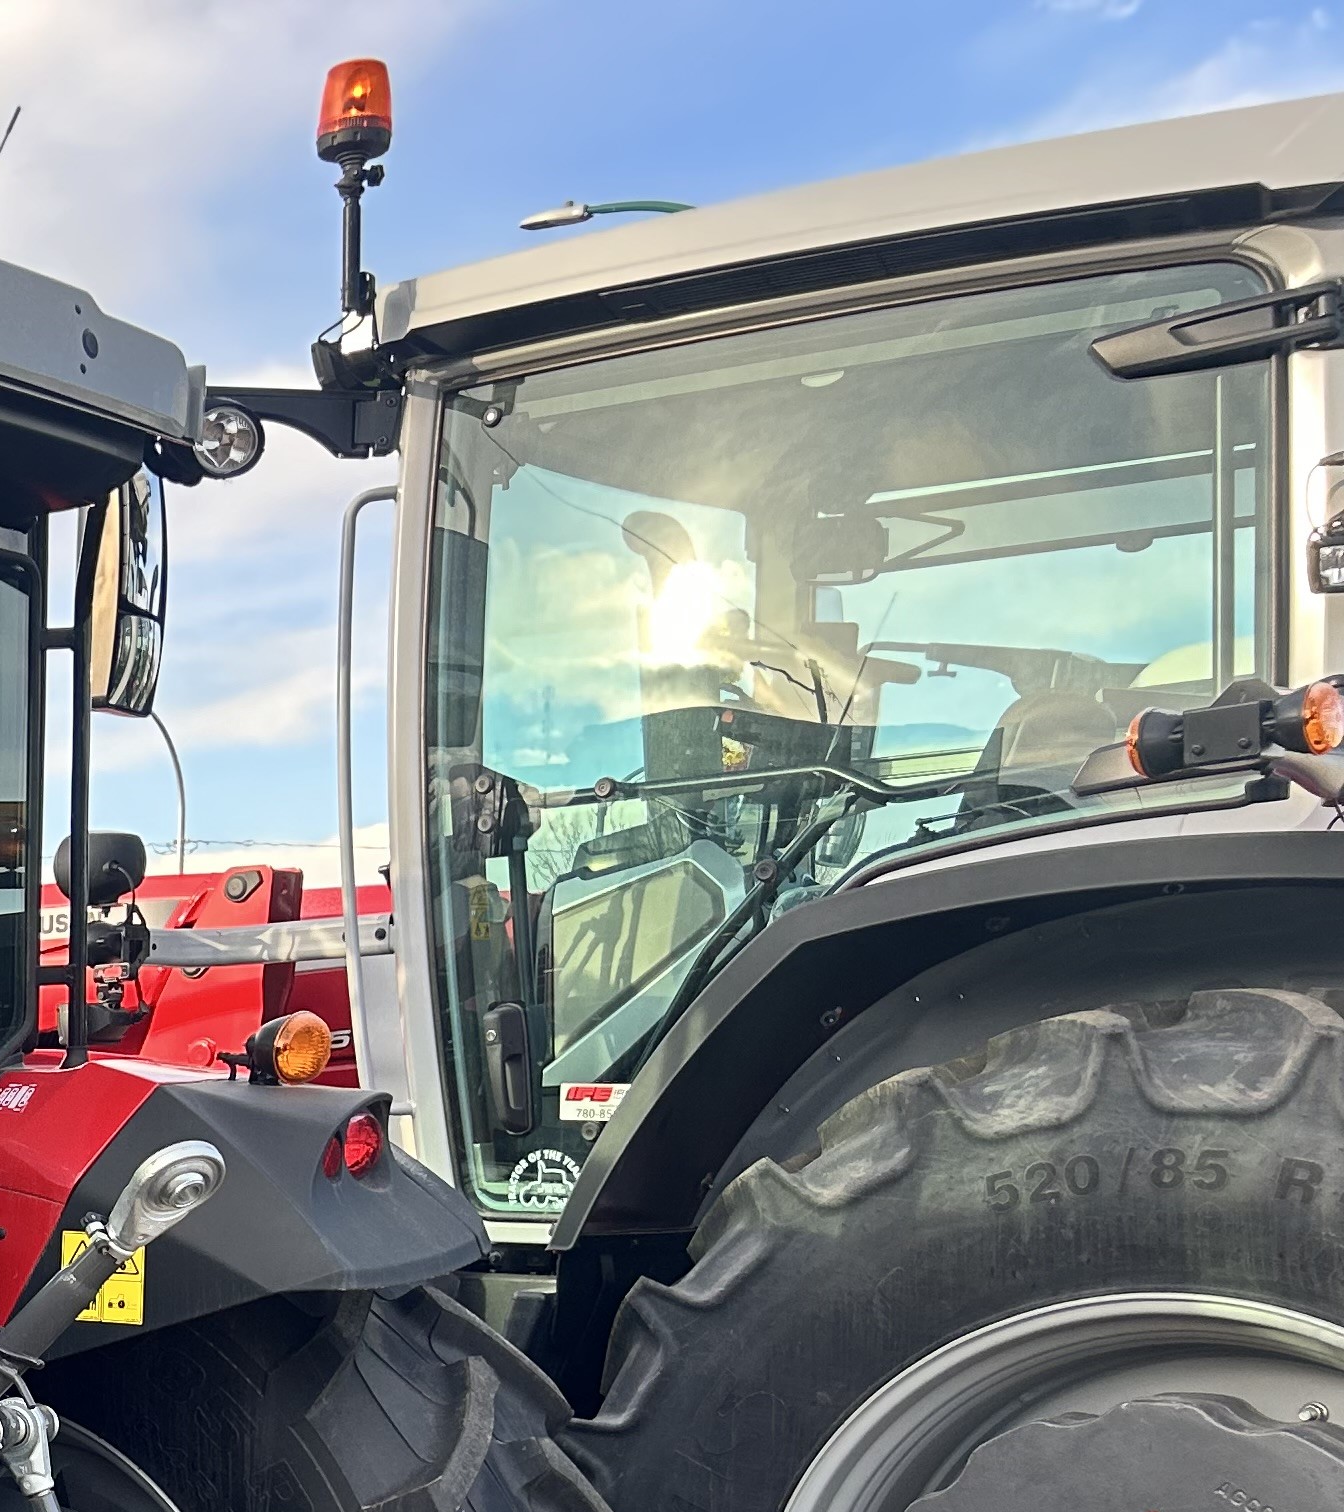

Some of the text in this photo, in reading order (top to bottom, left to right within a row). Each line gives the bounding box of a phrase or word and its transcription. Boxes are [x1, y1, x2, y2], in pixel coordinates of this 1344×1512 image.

[576, 1108, 612, 1118] 780-85
[528, 1150, 542, 1163] OF
[542, 1149, 563, 1162] THE
[562, 1155, 581, 1181] YEA
[984, 1146, 1325, 1213] 520/85 R
